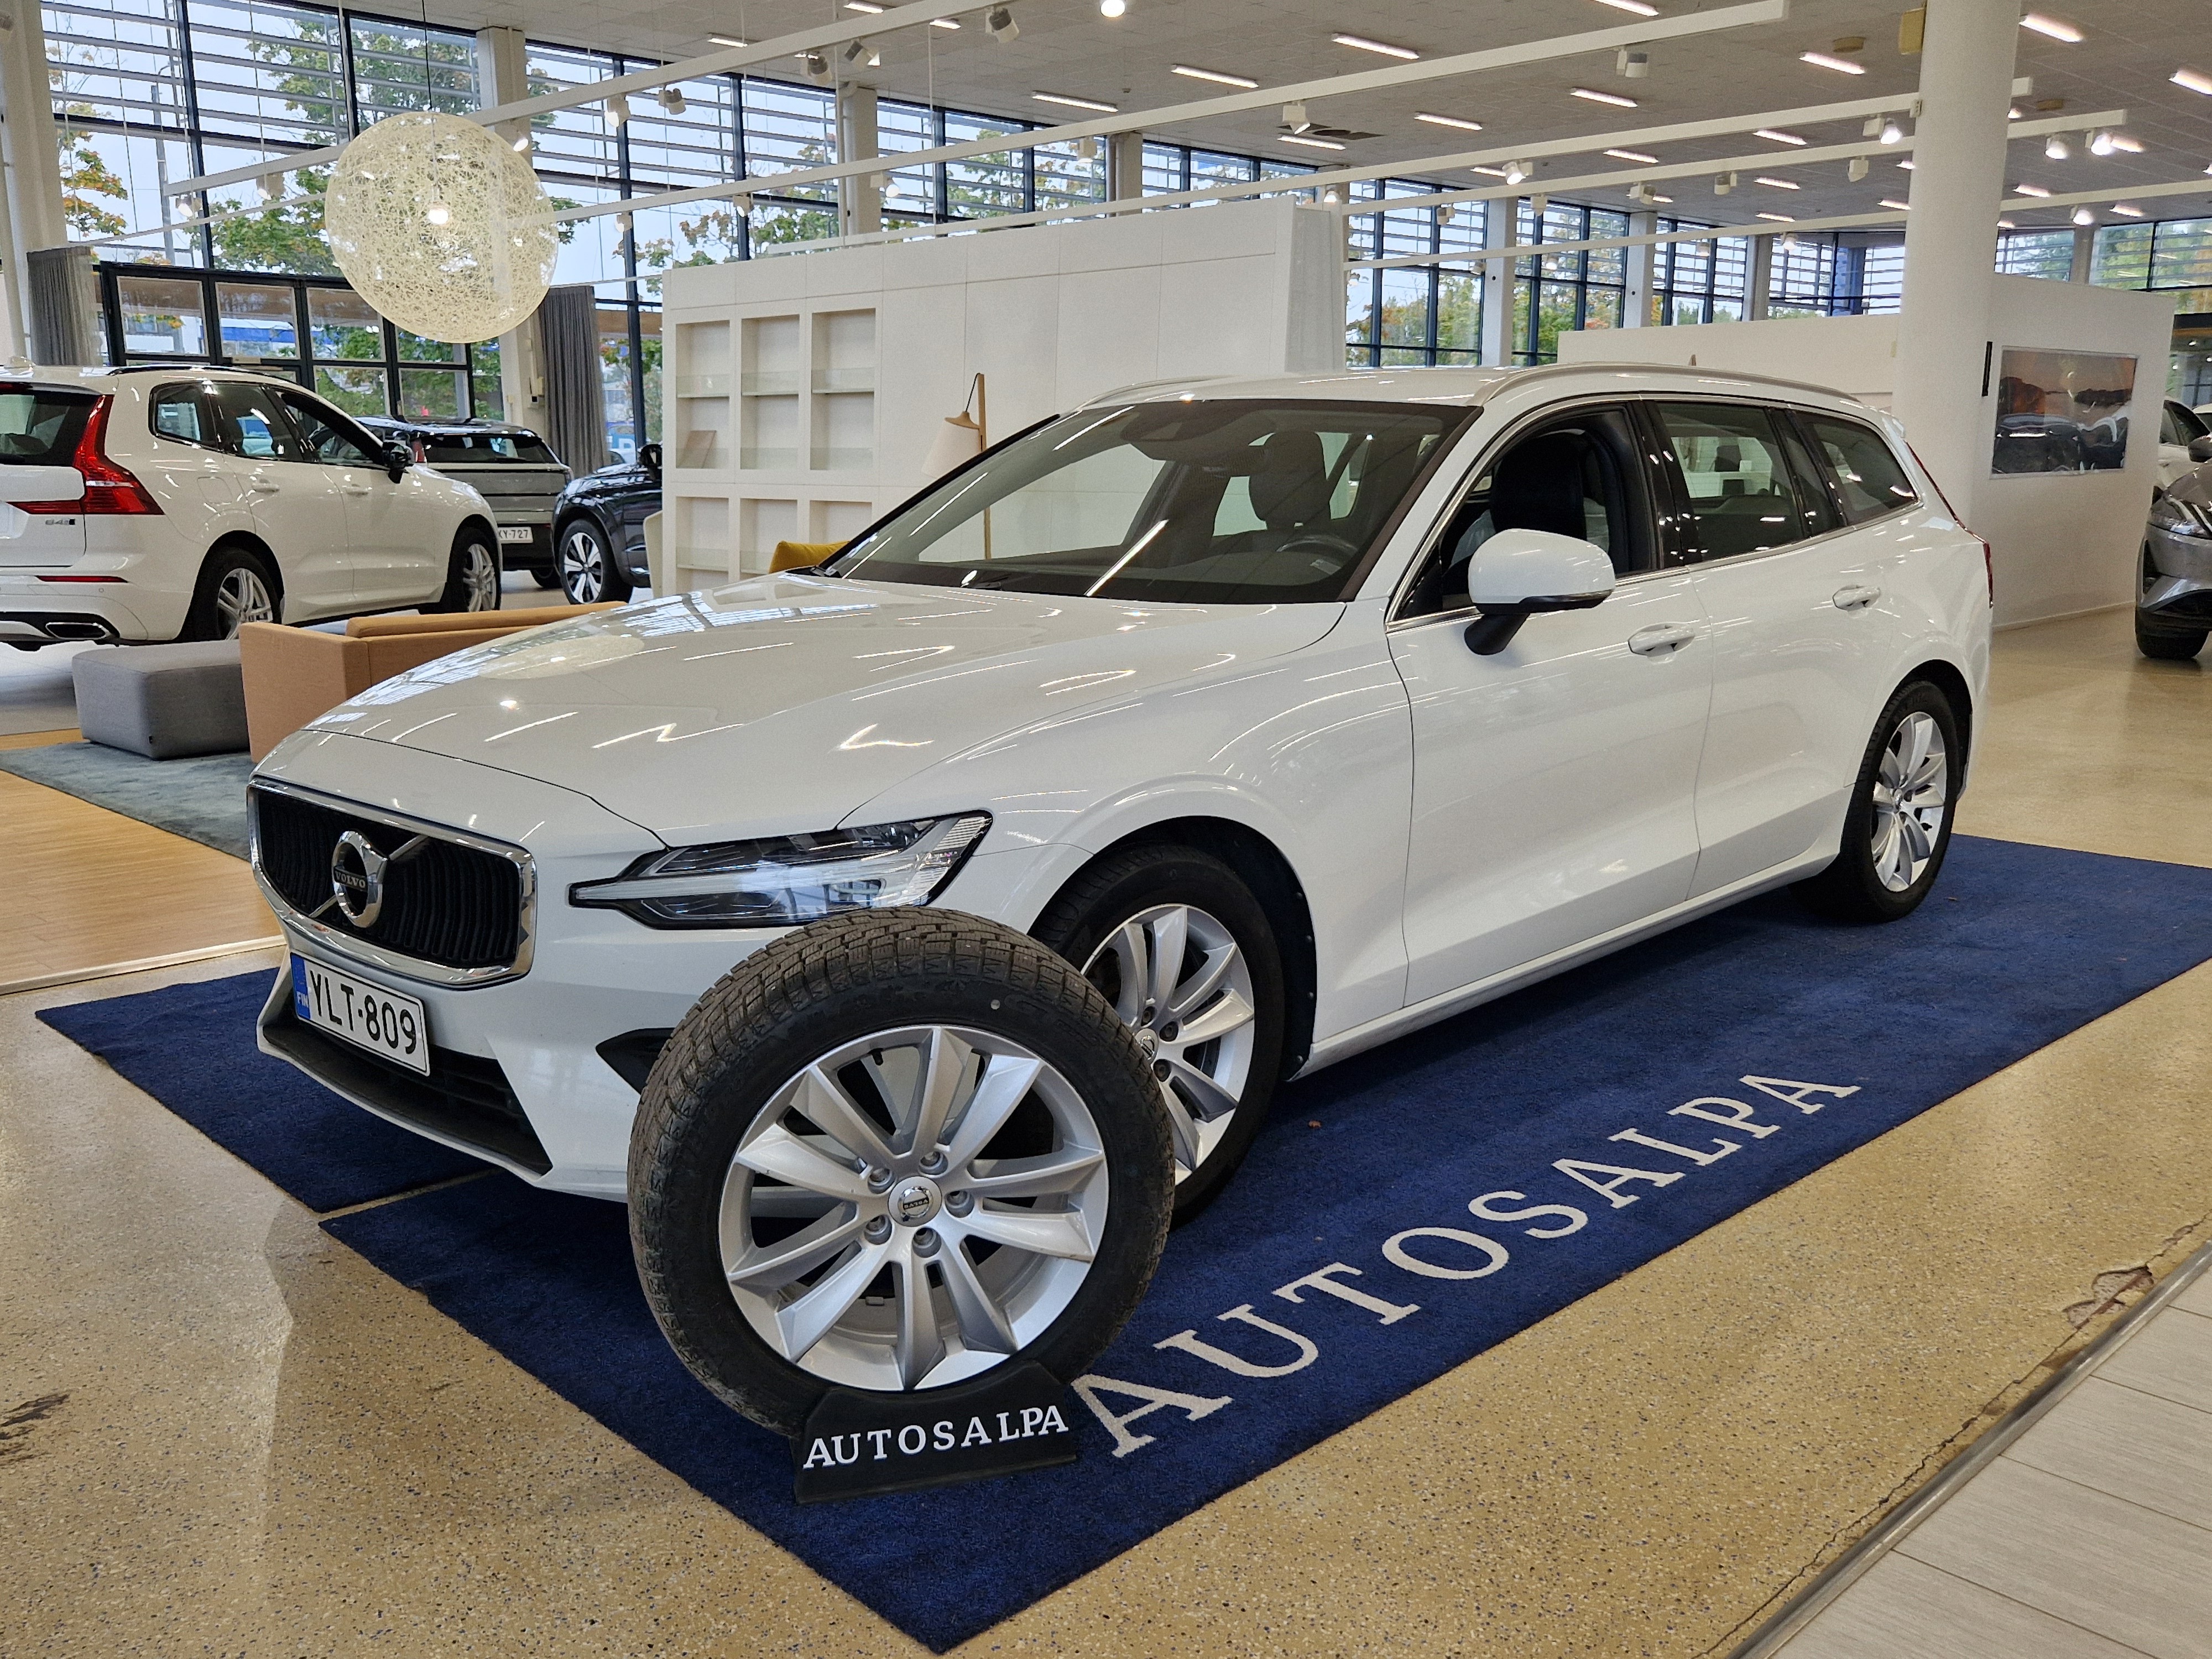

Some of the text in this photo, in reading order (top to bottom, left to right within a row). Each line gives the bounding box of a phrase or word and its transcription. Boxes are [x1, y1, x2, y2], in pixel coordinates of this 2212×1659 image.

[335, 870, 366, 889] VOLVO
[296, 991, 309, 1008] FIN
[310, 970, 416, 1055] YLT-809
[1071, 1074, 1861, 1458] AUTOSALPA
[803, 1405, 1069, 1469] AUTOSALPA
